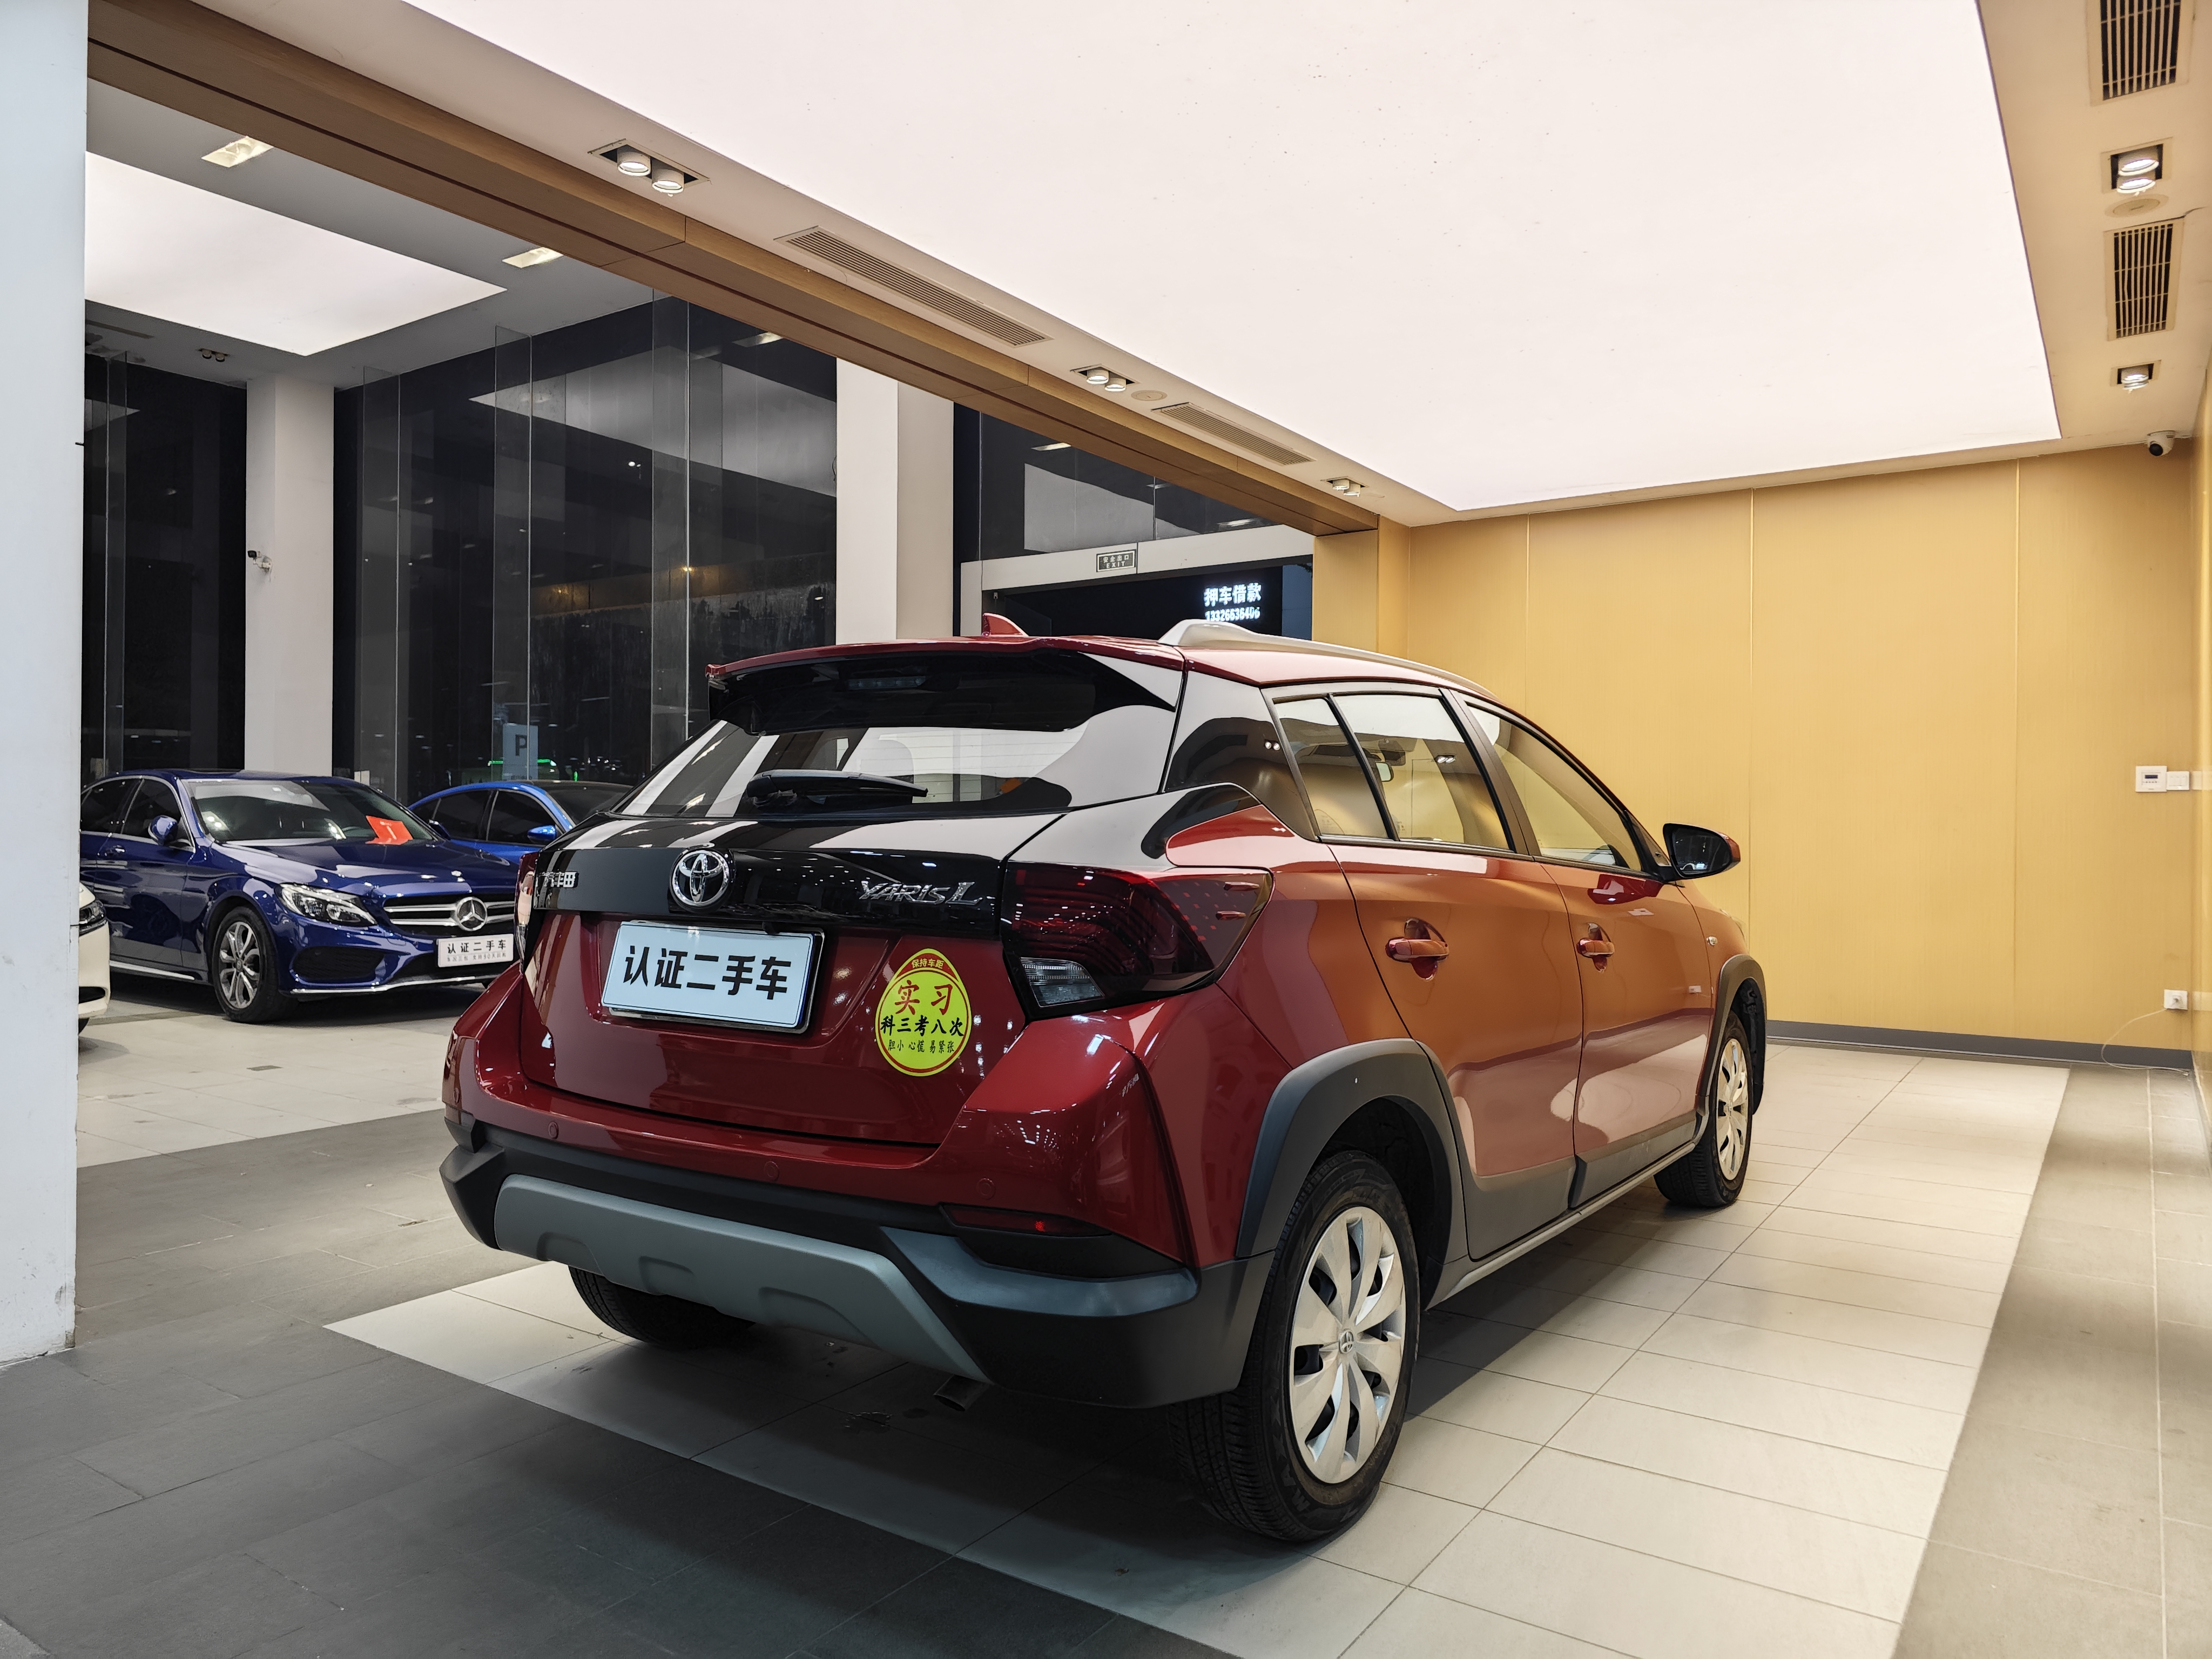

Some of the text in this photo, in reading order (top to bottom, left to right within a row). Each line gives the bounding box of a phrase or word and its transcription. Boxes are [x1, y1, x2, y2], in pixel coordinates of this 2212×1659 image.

[1103, 555, 1129, 563] 安全出口
[1204, 583, 1262, 606] 押车借款
[515, 734, 529, 756] P
[859, 880, 983, 905] YARIS L
[447, 939, 507, 954] 认证二手车
[623, 945, 792, 1000] 认证二手车
[912, 959, 944, 969] 保持车距
[894, 980, 953, 1015] 实习
[880, 1015, 965, 1036] 科三考八次
